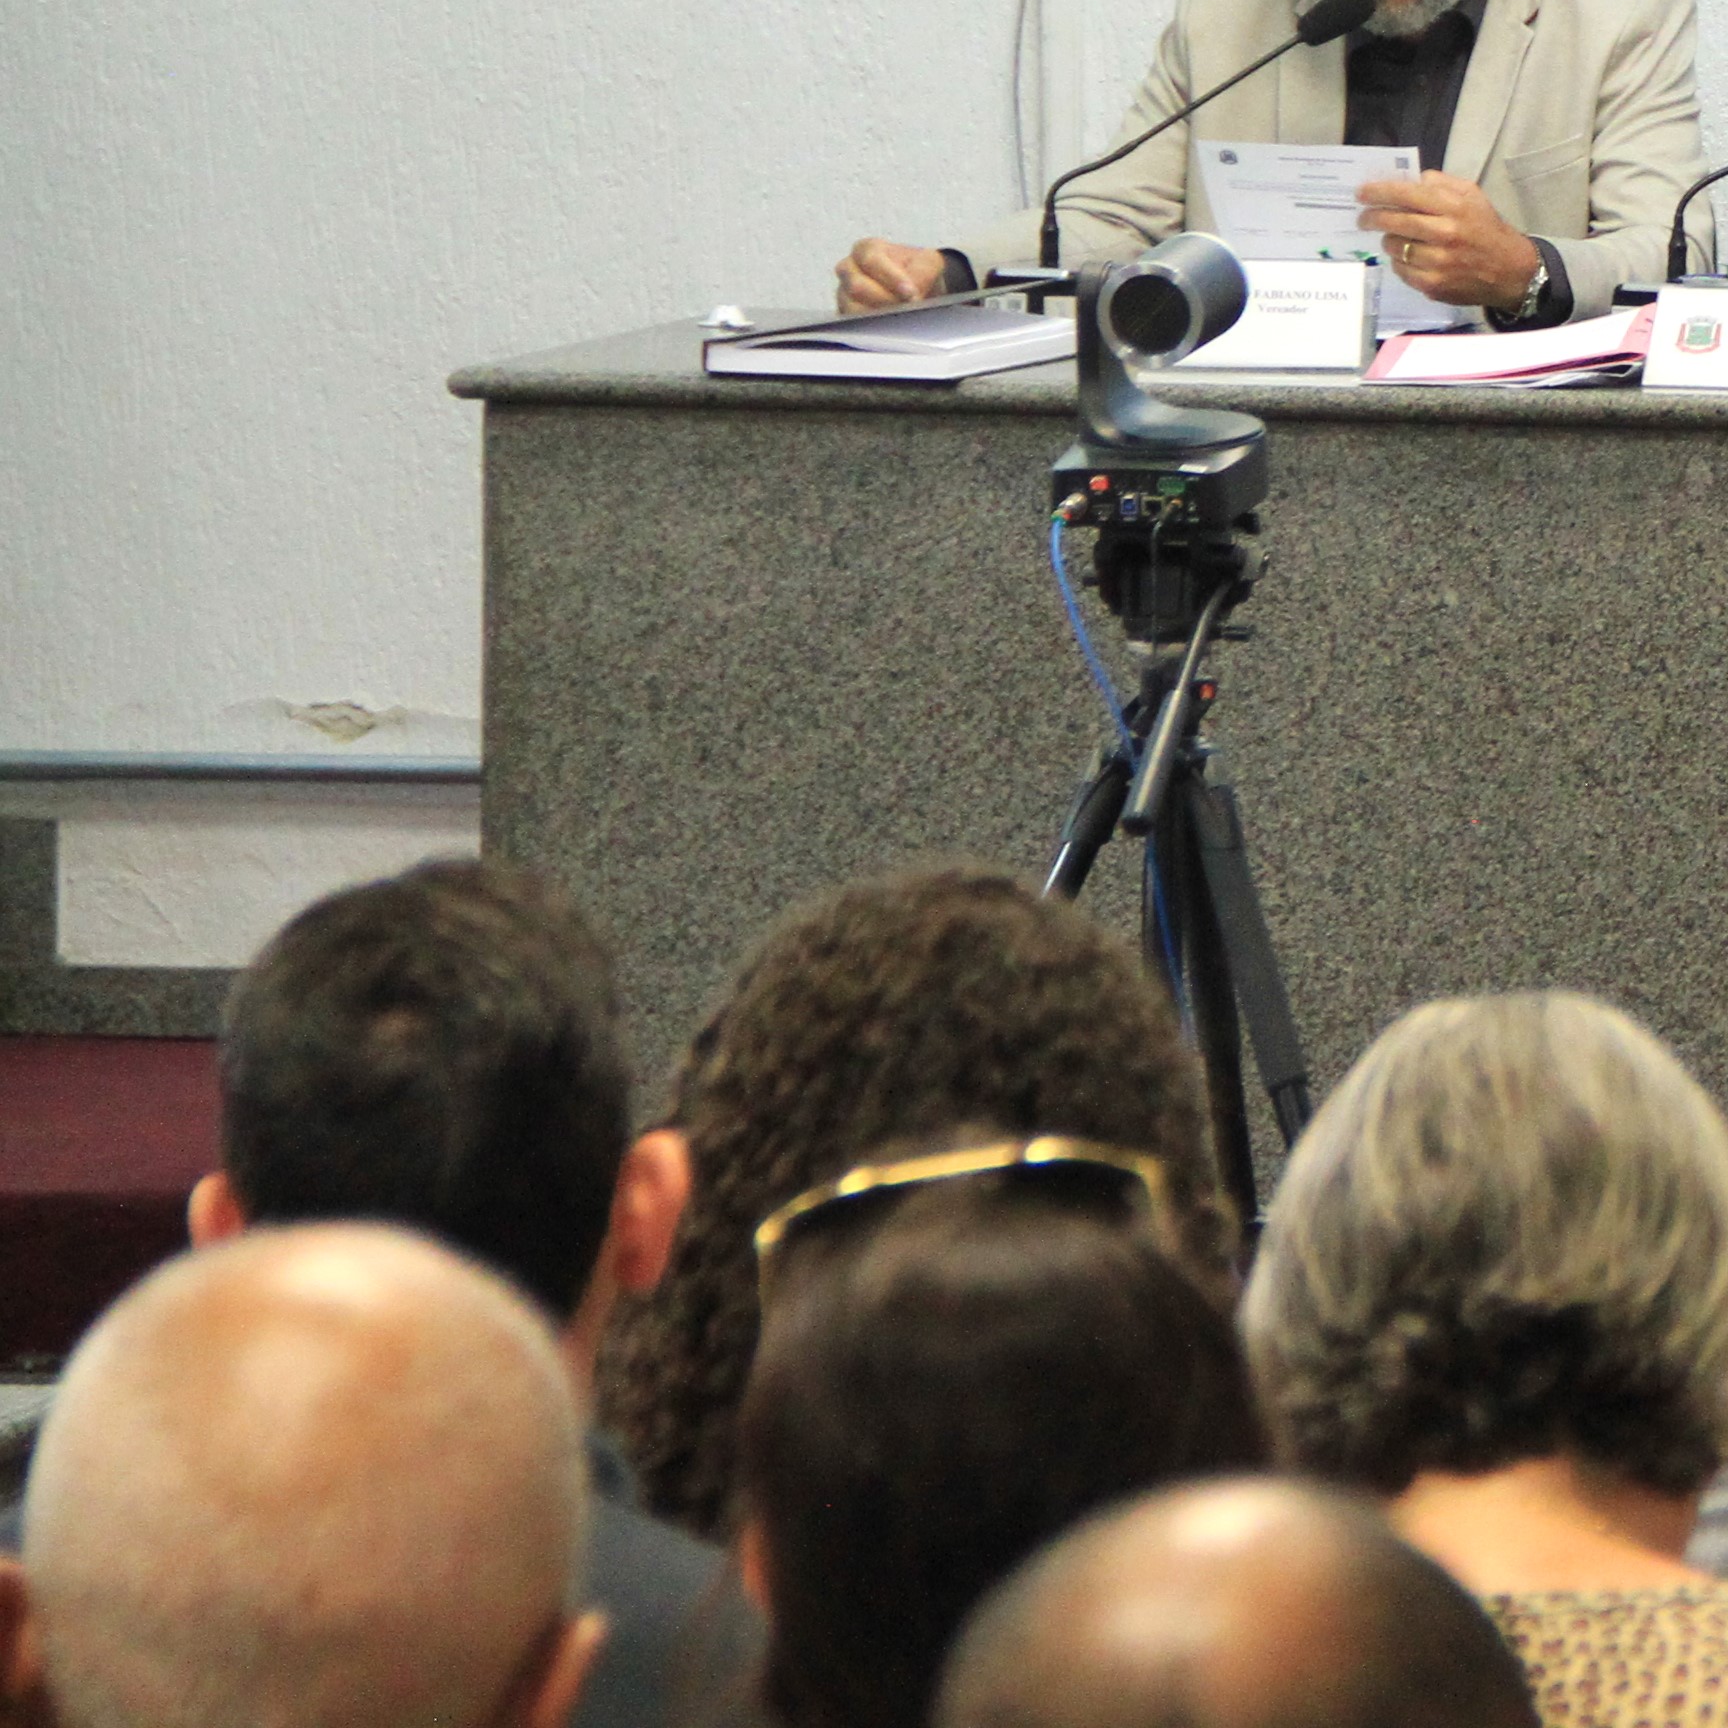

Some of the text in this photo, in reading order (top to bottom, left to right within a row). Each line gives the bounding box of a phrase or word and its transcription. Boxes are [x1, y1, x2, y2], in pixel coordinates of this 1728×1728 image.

[1253, 289, 1348, 301] FABIANO LIMA
[1257, 305, 1309, 314] Vereador
